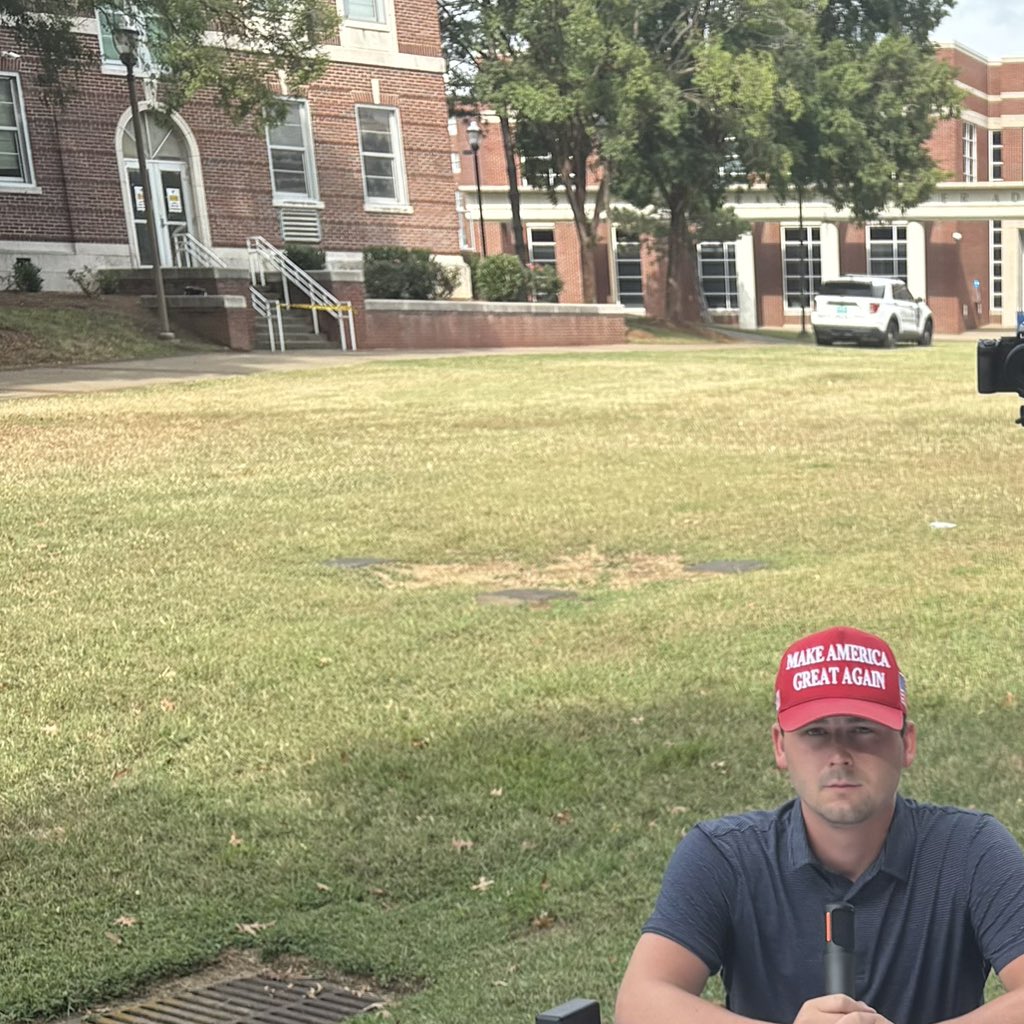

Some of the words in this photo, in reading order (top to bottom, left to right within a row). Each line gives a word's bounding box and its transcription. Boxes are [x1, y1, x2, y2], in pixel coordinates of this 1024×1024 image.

[786, 645, 825, 670] MAKE
[826, 643, 891, 668] AMERICA
[792, 666, 840, 691] GREAT
[841, 666, 886, 690] AGAIN
